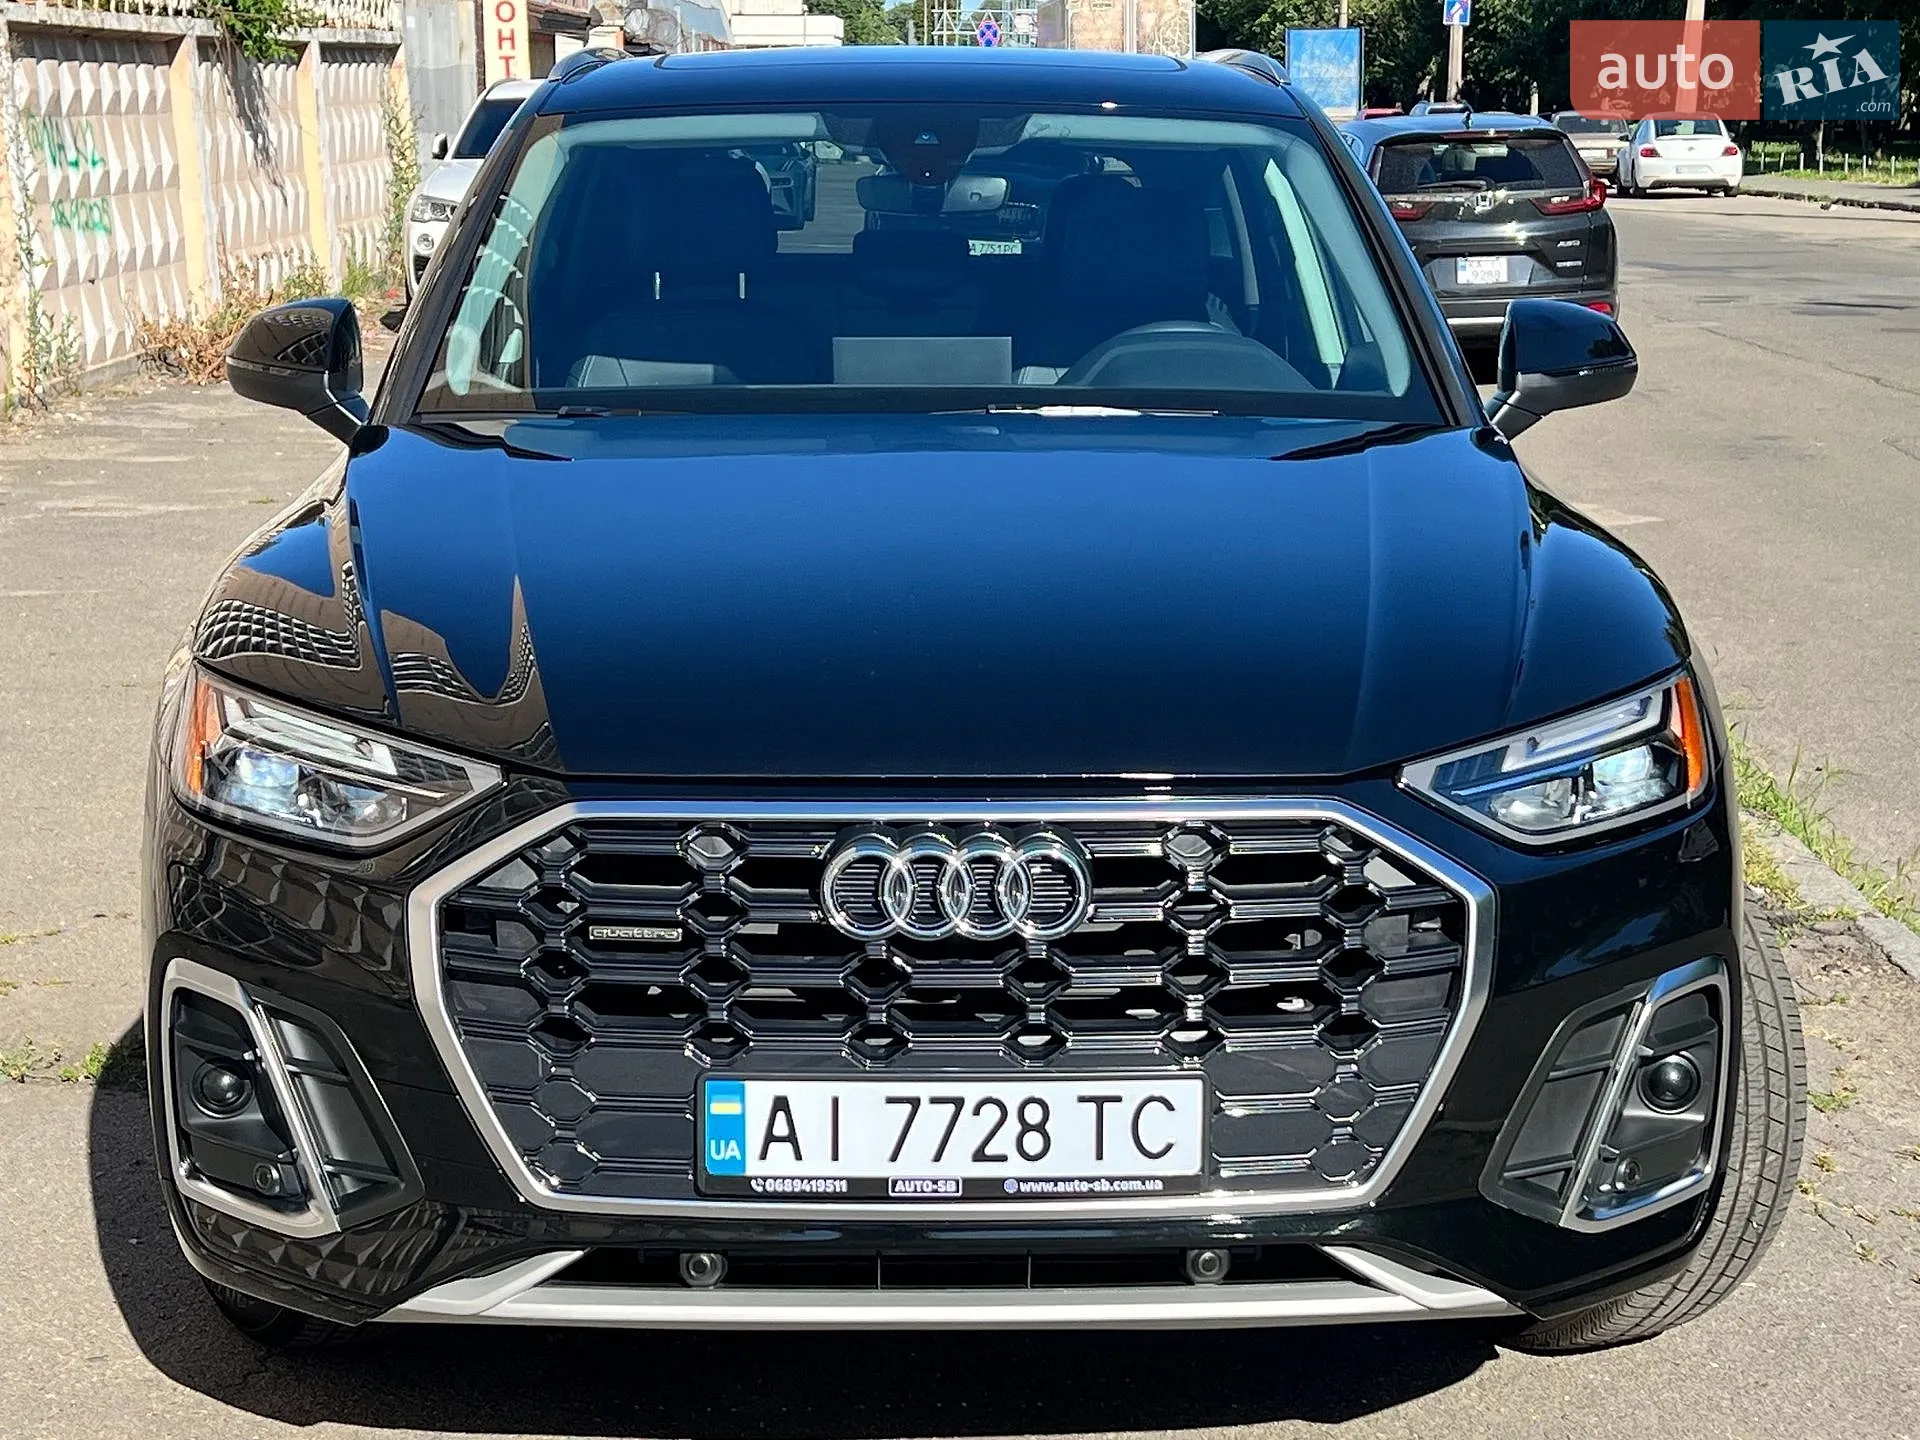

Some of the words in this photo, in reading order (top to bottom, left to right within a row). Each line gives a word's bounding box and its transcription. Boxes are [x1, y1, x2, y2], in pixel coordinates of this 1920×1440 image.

[593, 929, 679, 939] quattro
[885, 1095, 1051, 1162] 7728
[1076, 1095, 1177, 1161] TC
[709, 1139, 742, 1161] UA
[765, 1178, 849, 1193] 0689419511
[894, 1179, 957, 1193] AUTO-SB
[1019, 1178, 1164, 1193] www.auto-sb.com.ua
